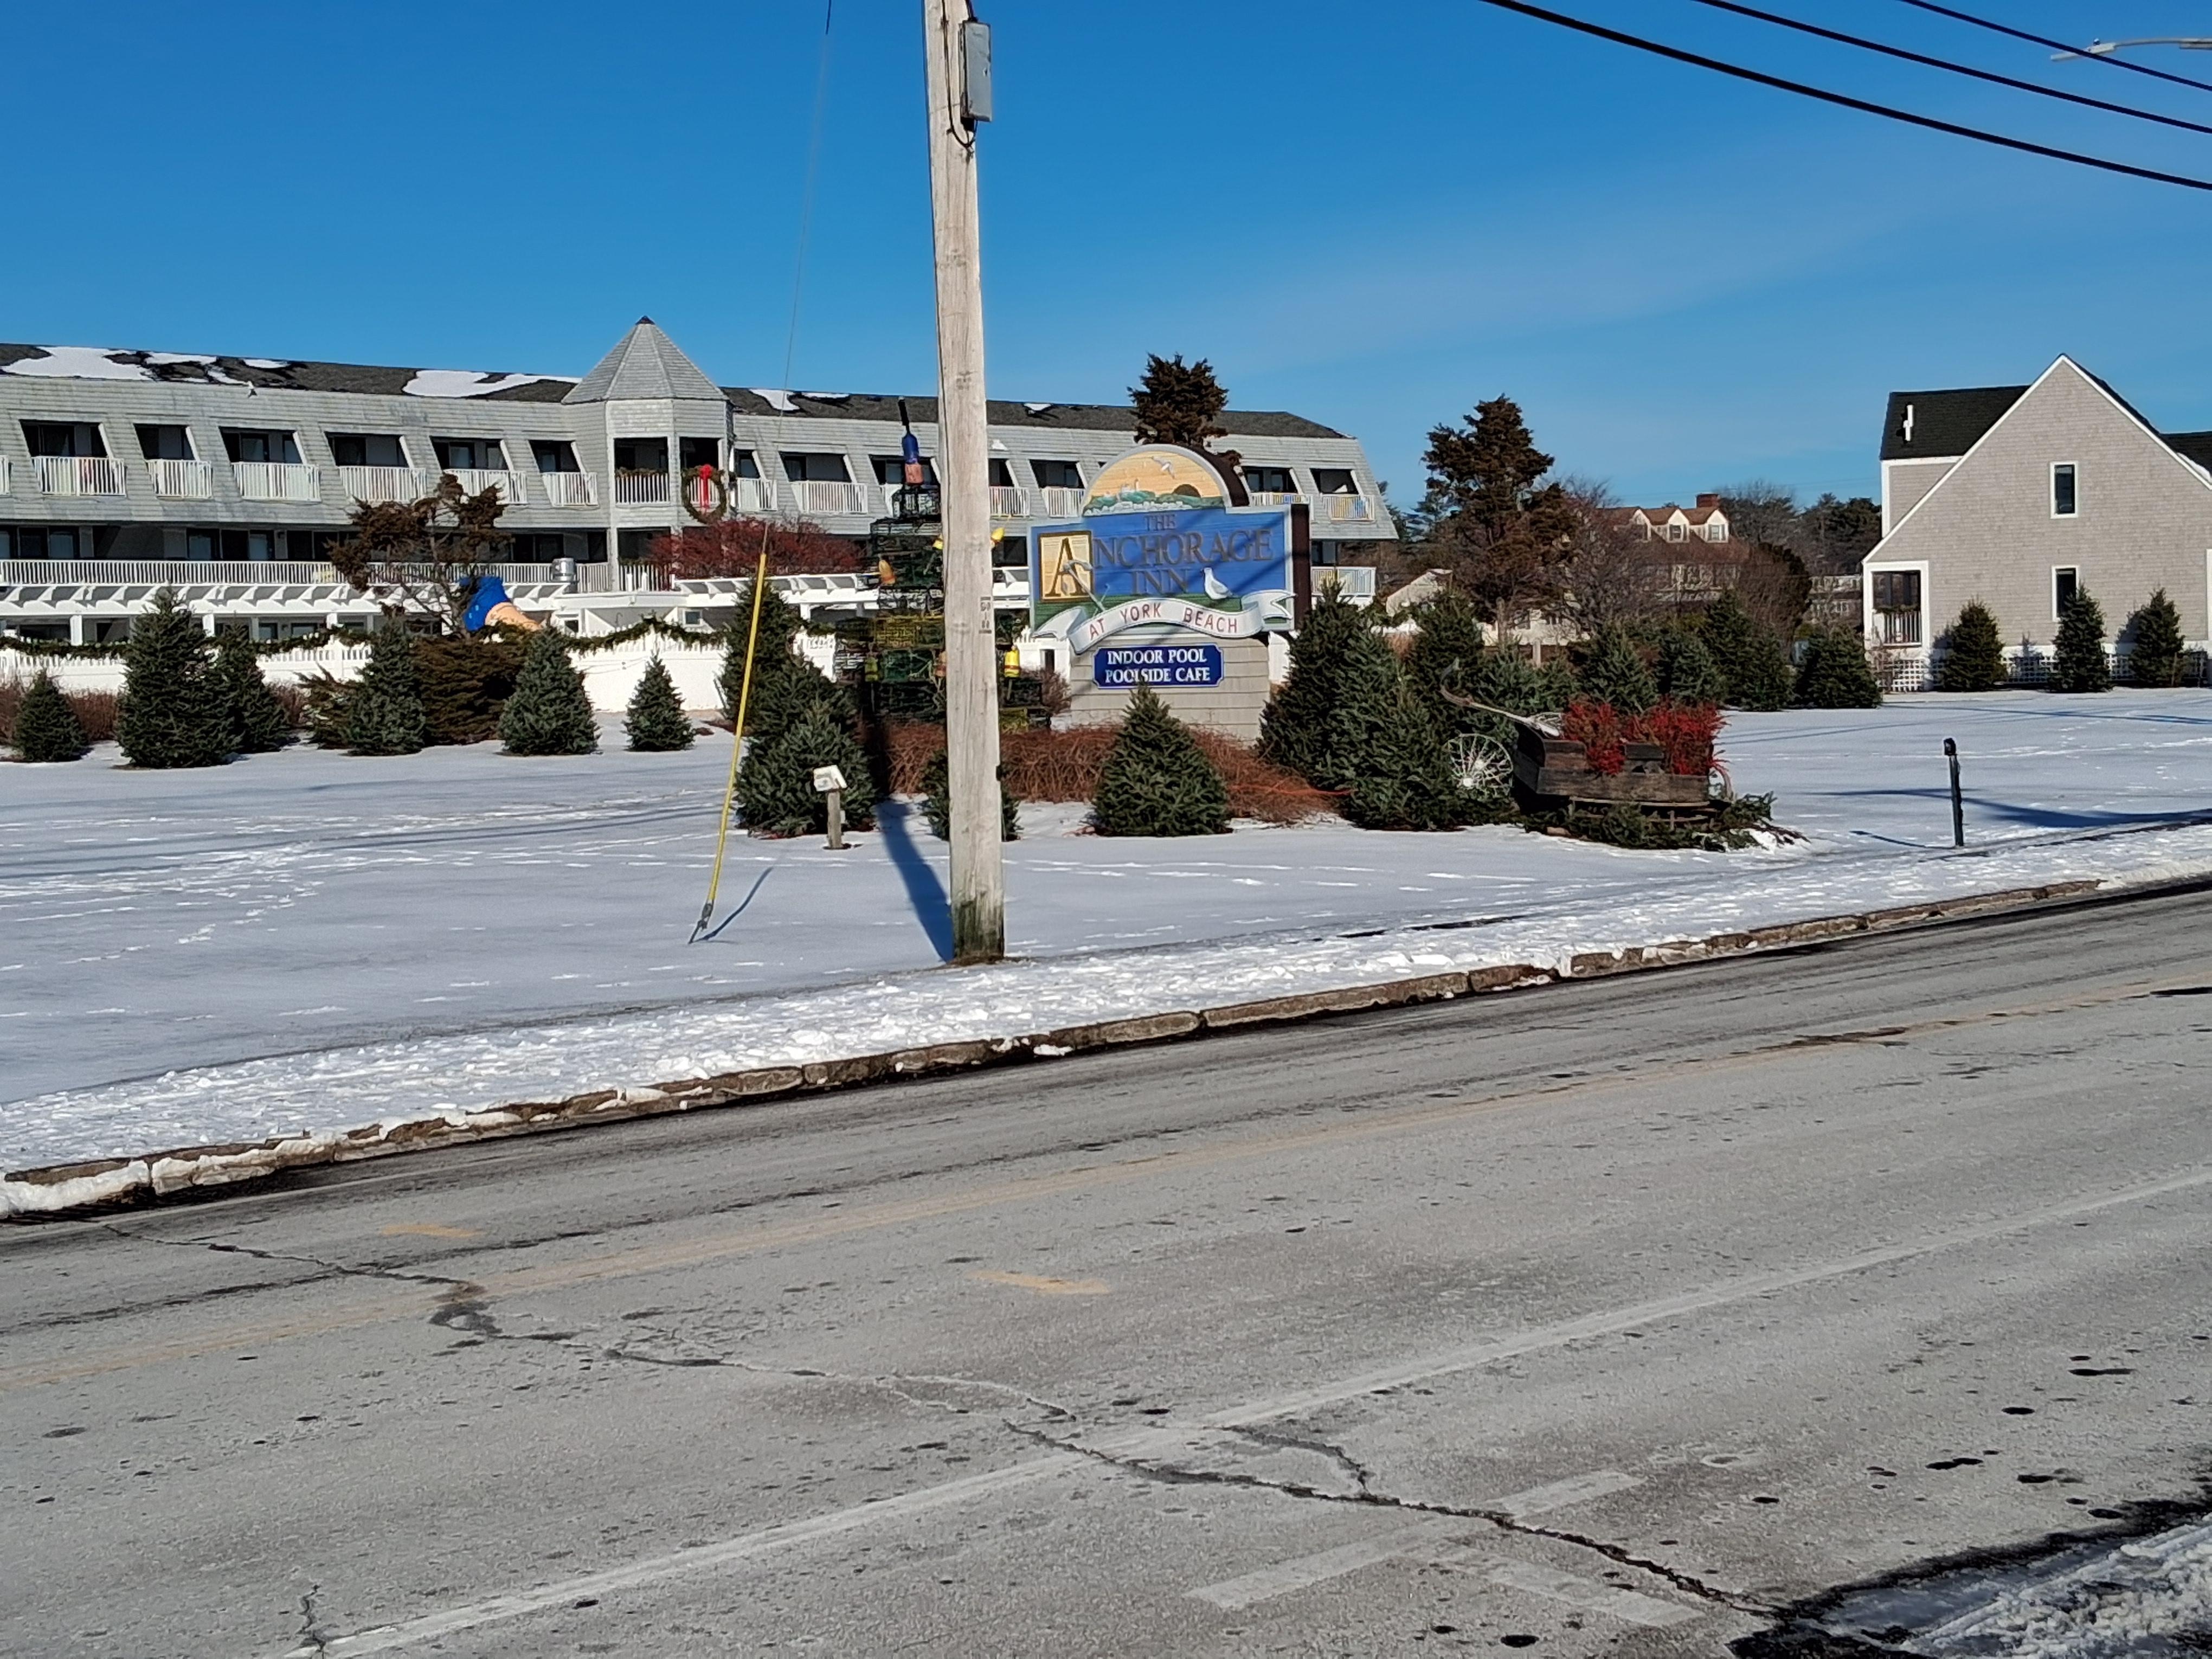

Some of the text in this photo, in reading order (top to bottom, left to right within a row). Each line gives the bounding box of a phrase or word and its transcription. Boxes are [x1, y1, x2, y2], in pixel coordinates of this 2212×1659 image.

[1144, 515, 1176, 531] THE
[1044, 530, 1272, 597] ANCHORAGE
[1132, 569, 1188, 595] INN
[1089, 603, 1238, 640] AT YORK BEACH
[1107, 649, 1207, 665] INDOOR POOL
[1105, 667, 1210, 683] POOLSIDE CAFE
